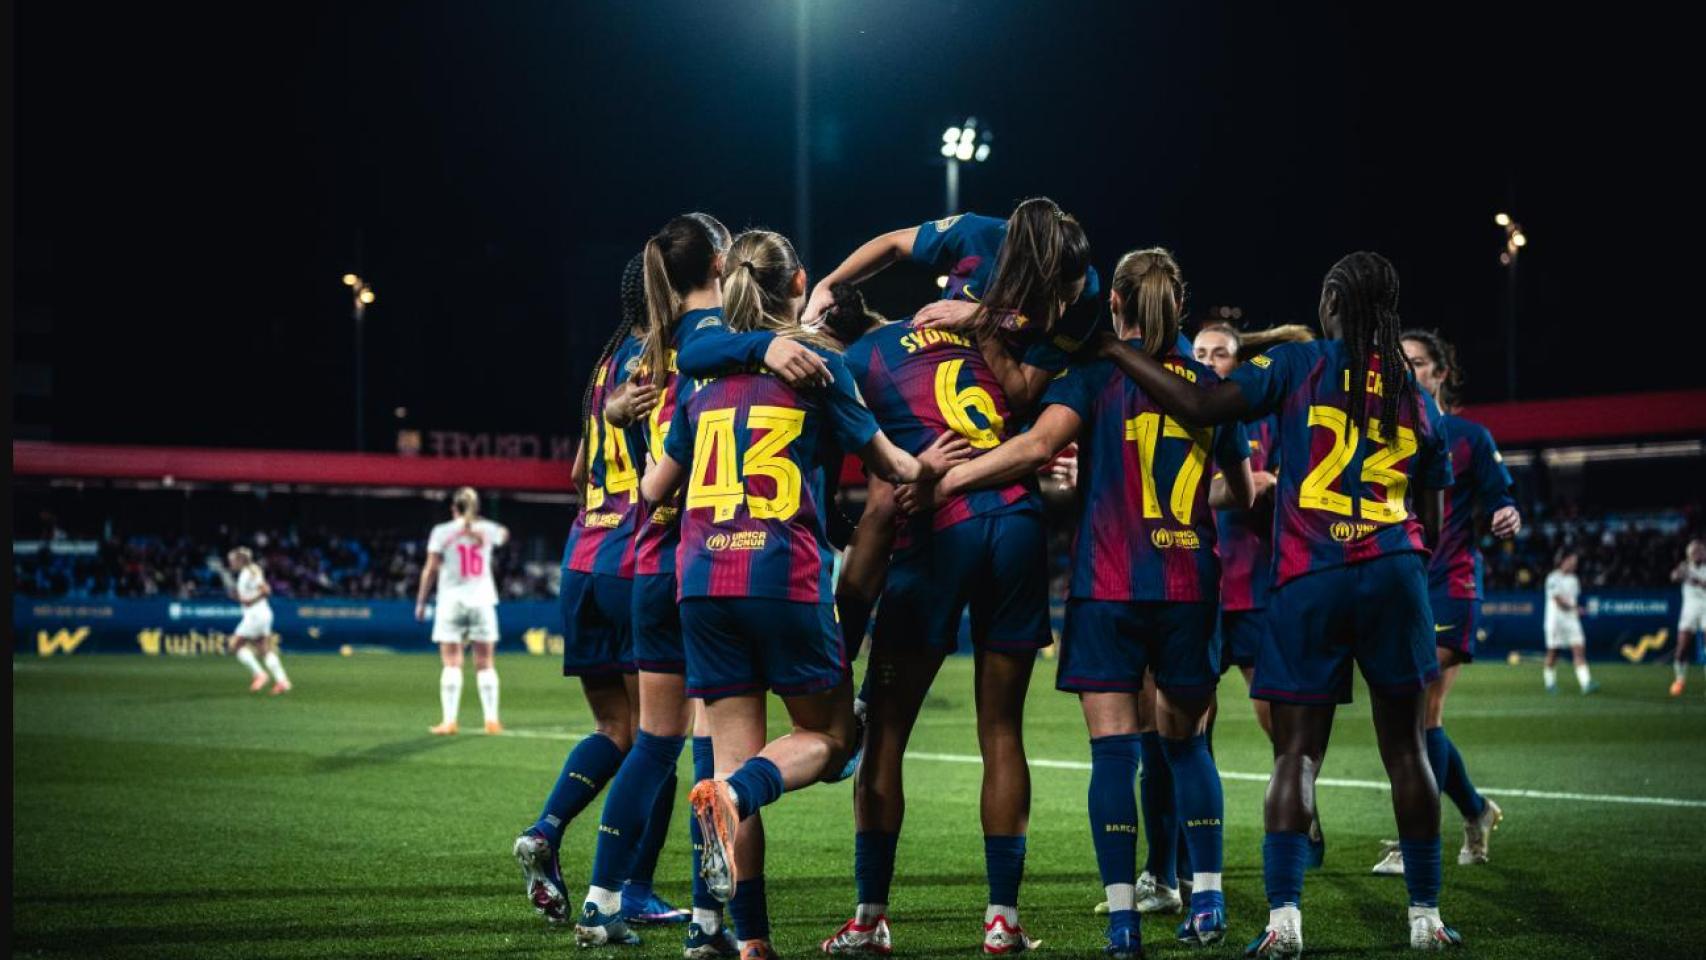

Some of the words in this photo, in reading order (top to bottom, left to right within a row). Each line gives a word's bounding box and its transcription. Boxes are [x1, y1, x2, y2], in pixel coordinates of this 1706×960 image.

[935, 358, 1004, 450] 6
[686, 405, 806, 523] 43
[1125, 411, 1214, 526] 17
[1298, 405, 1418, 524] 23
[456, 543, 483, 577] 16
